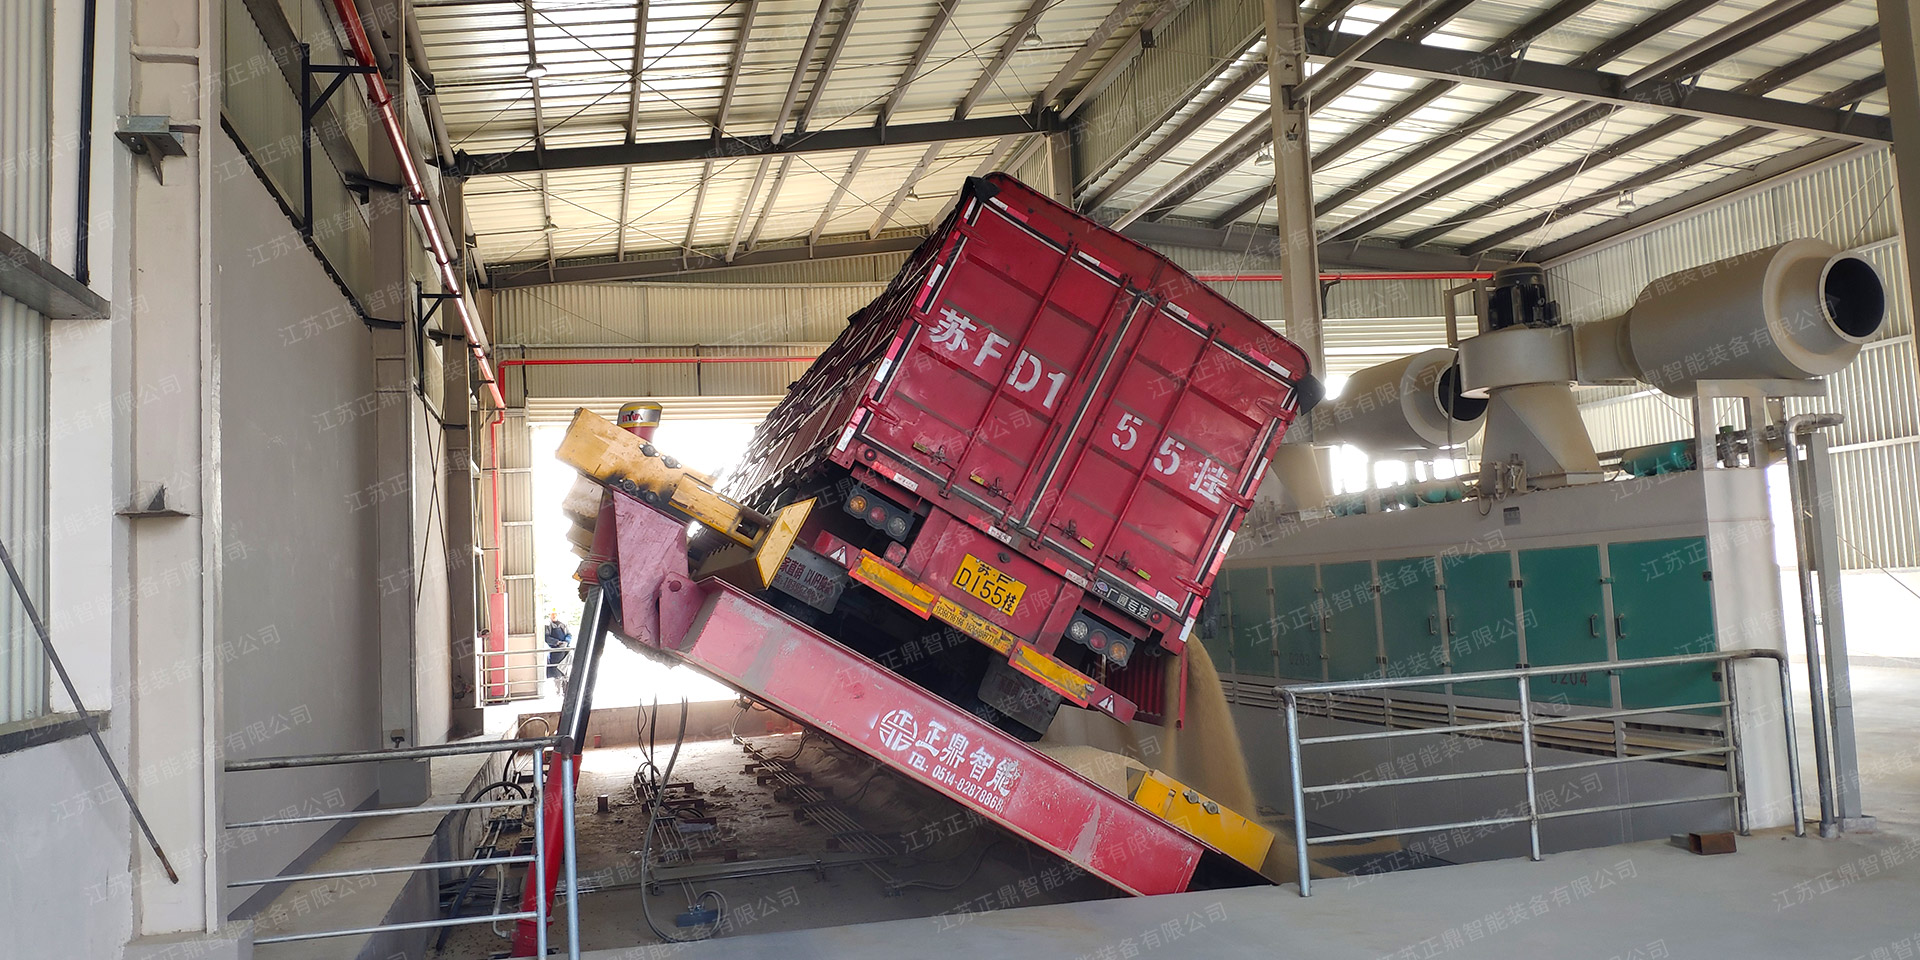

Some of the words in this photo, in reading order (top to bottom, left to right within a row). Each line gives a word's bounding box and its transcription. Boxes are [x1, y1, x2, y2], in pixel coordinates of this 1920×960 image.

[928, 307, 1067, 409] 苏FD1
[956, 567, 1016, 612] D155挂
[907, 751, 930, 773] TEL:
